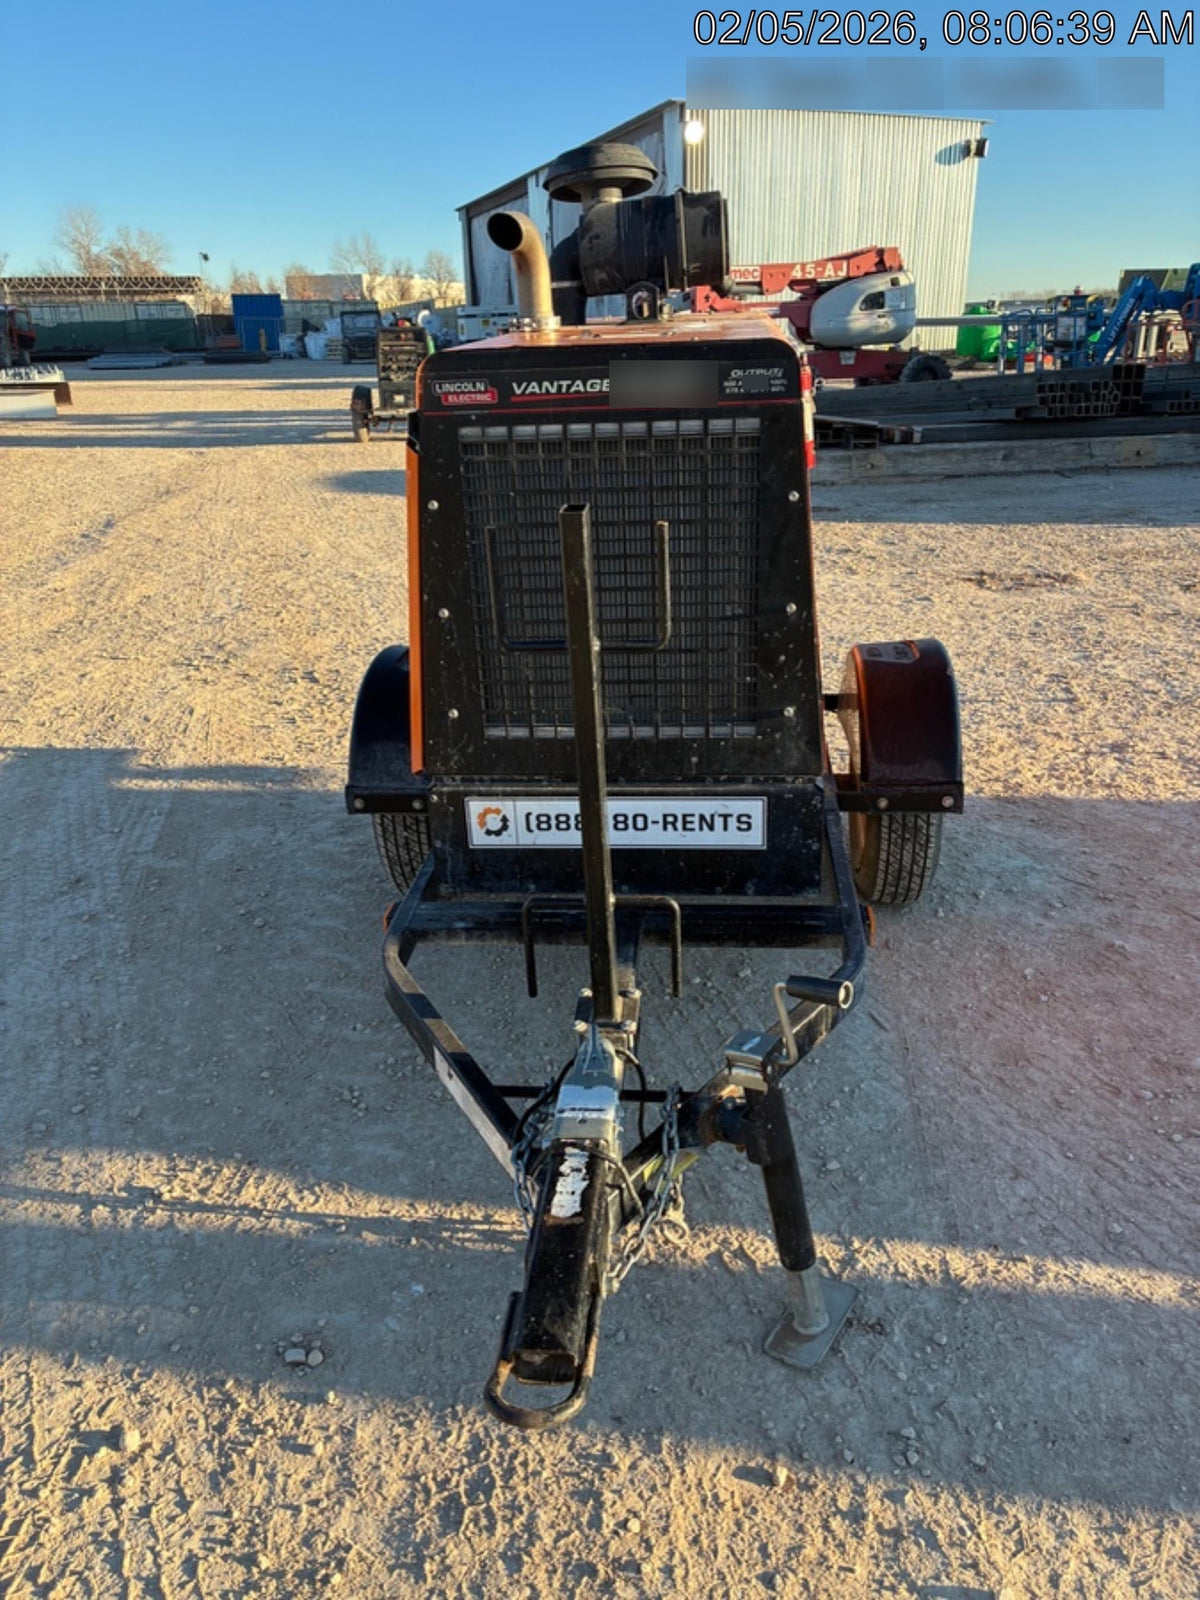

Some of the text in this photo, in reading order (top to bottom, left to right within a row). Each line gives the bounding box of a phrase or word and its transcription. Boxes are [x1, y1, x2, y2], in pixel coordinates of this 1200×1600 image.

[792, 260, 848, 279] 45-AJ
[434, 381, 486, 393] LINCOLN
[511, 379, 609, 395] VANTAGE
[448, 393, 492, 403] ELECTRIC
[525, 812, 753, 833] (88 80-RENTS
